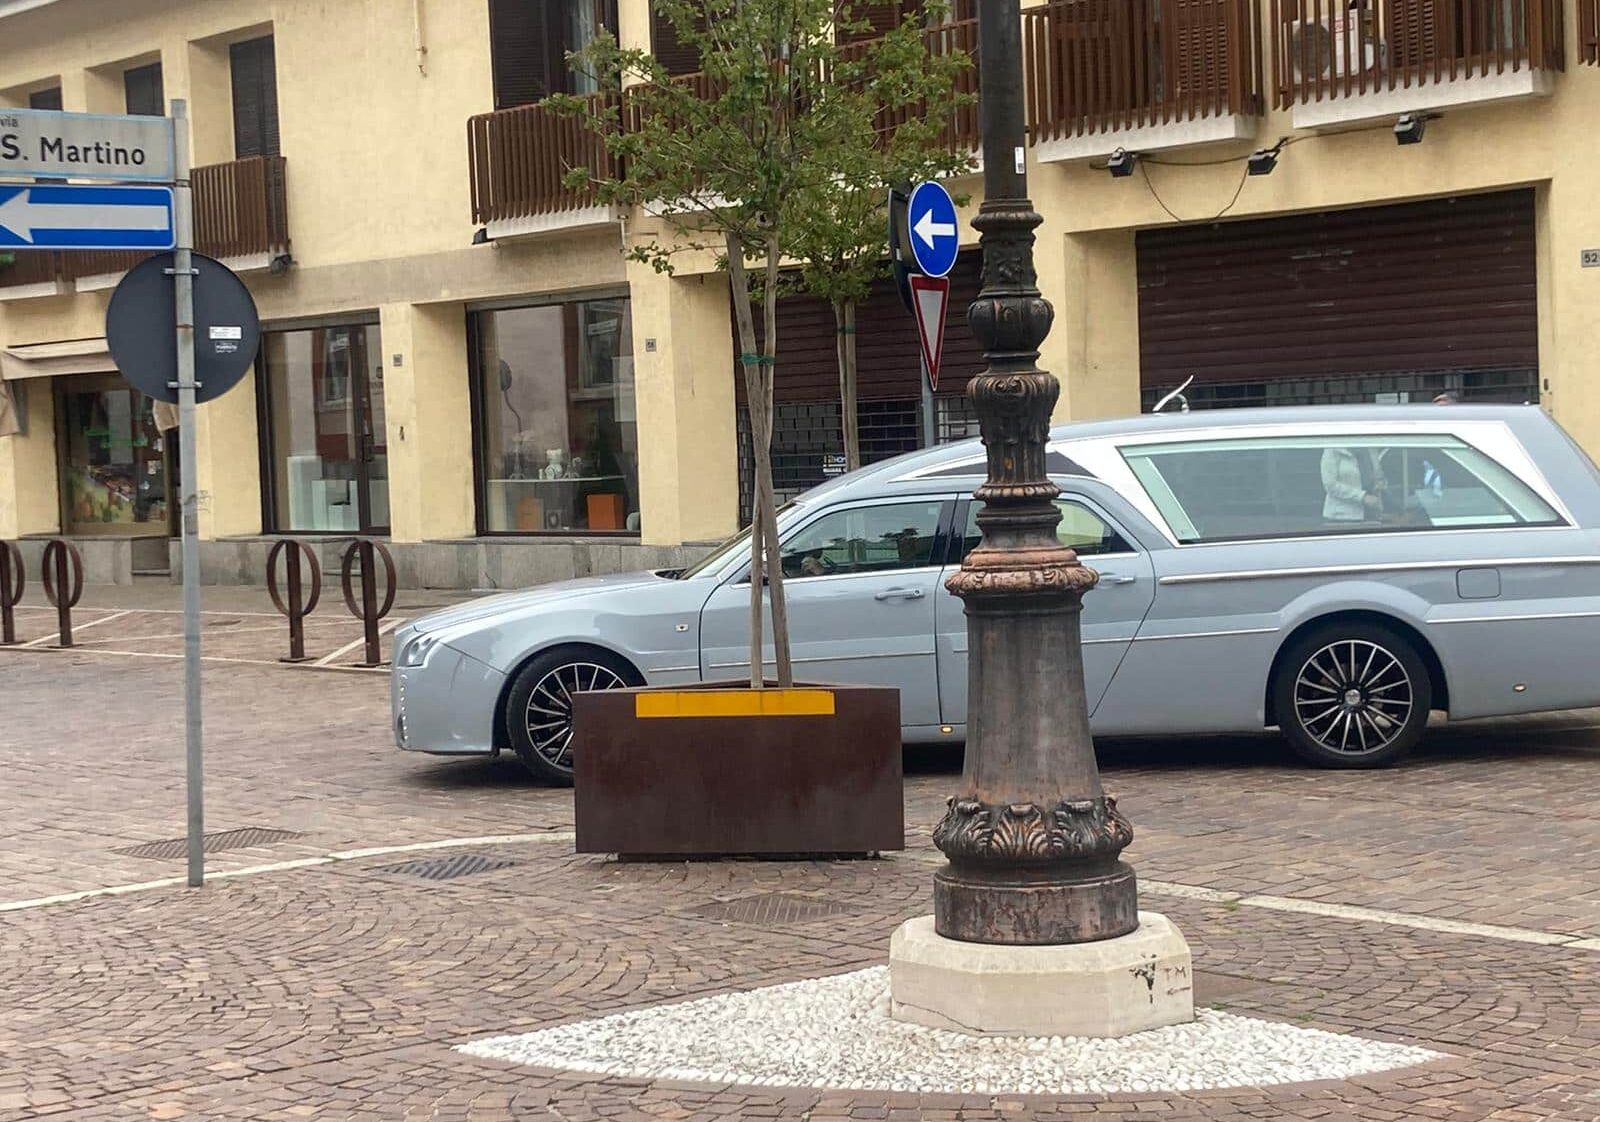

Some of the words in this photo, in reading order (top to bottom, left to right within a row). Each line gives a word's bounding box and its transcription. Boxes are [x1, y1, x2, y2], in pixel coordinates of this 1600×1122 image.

[0, 115, 18, 127] via
[1, 134, 28, 160] S.
[40, 136, 145, 165] Martino
